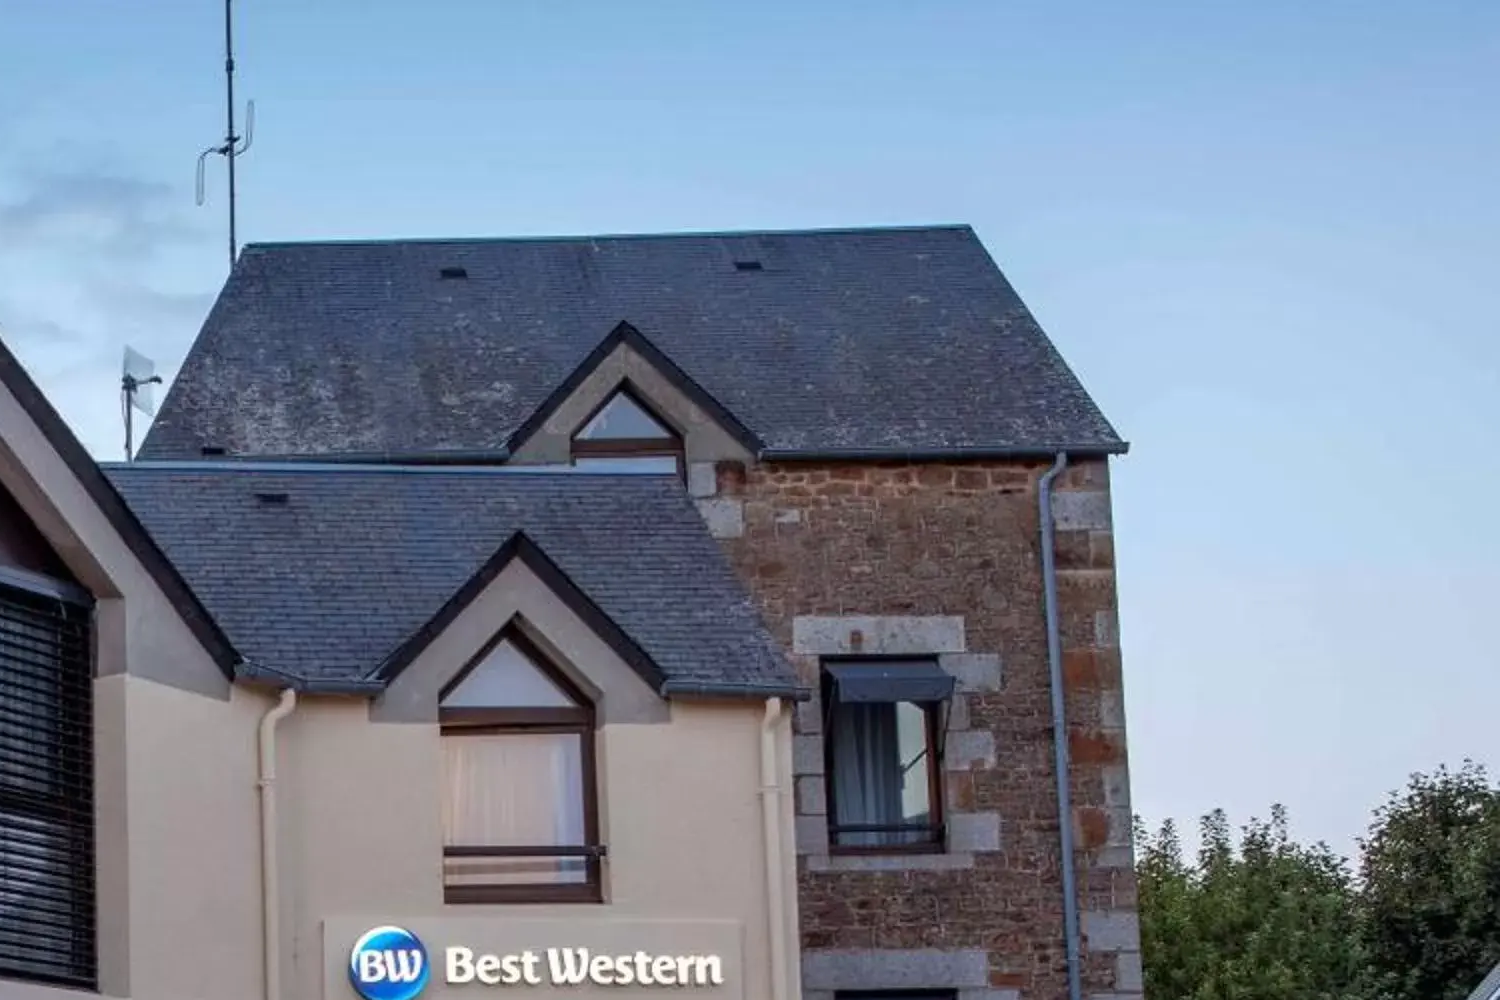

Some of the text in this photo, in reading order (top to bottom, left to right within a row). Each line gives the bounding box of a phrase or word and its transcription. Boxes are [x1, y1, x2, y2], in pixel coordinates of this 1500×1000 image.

[360, 950, 422, 982] BW
[445, 947, 724, 984] Best Western
